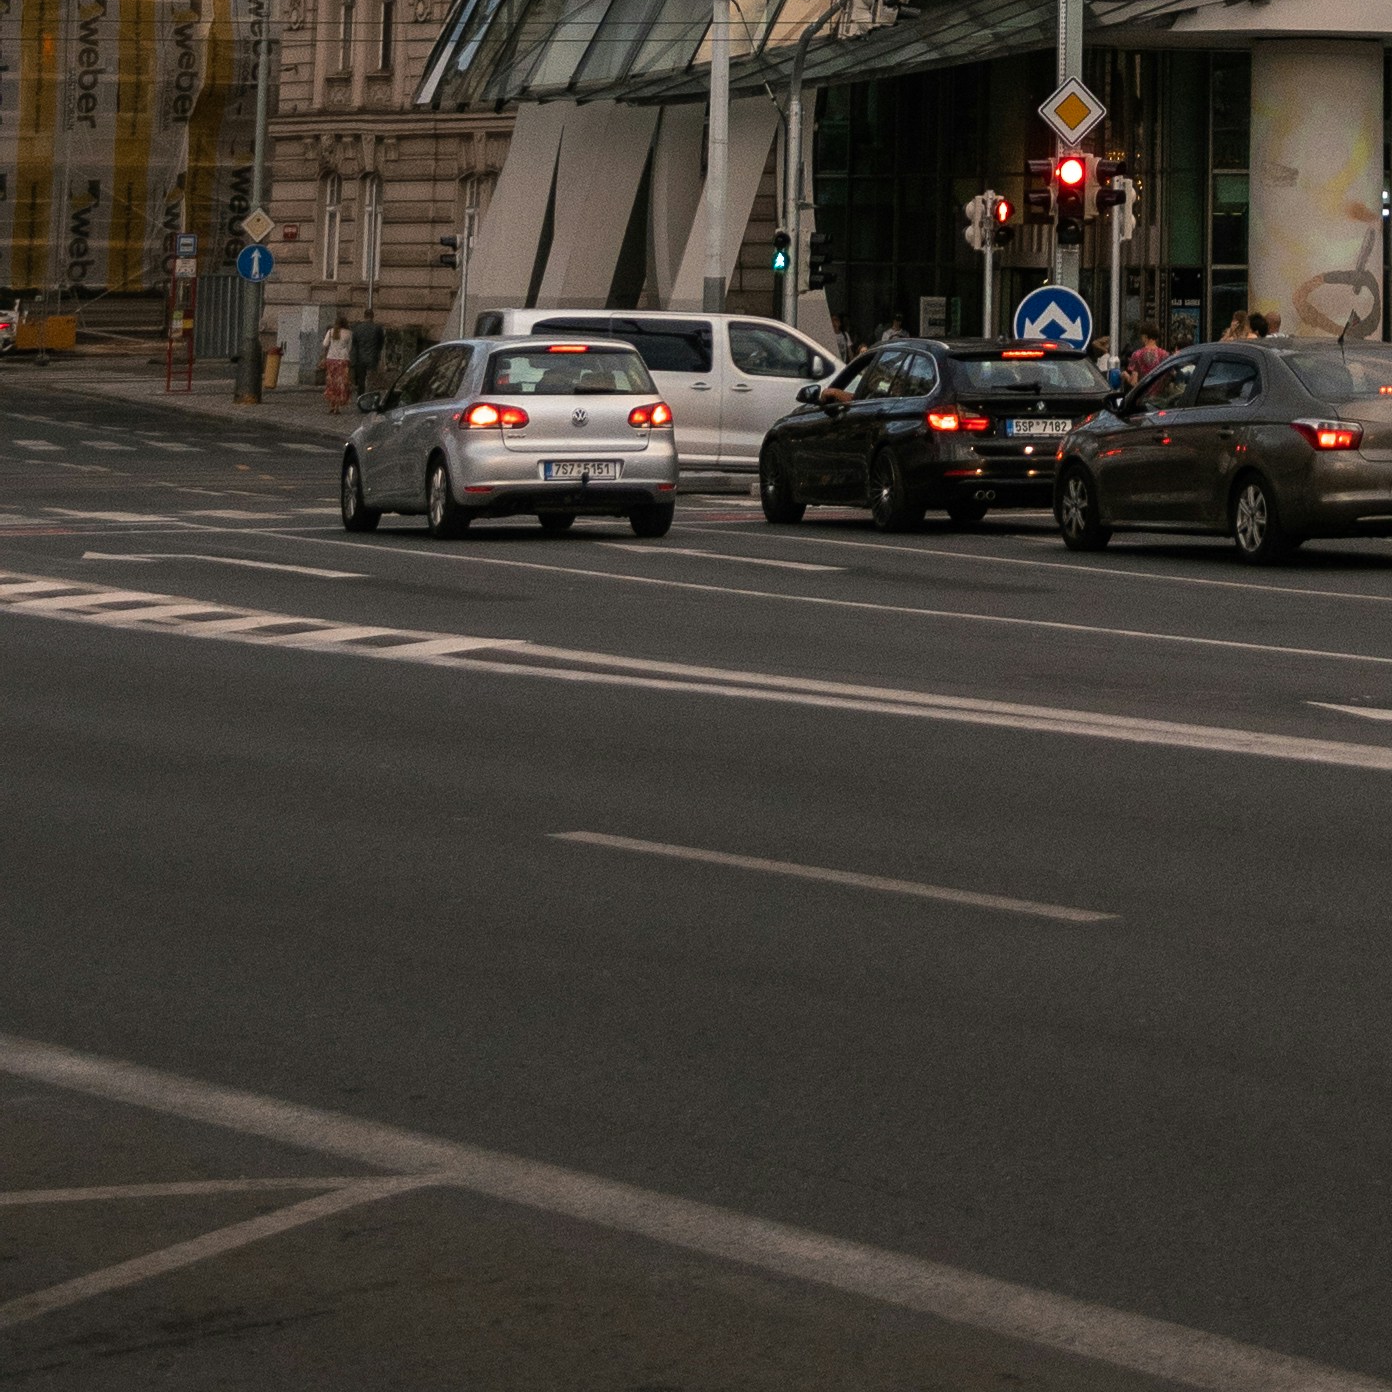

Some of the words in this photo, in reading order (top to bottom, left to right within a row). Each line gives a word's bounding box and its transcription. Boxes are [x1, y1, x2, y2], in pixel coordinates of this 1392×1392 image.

[77, 16, 106, 129] weber
[1014, 420, 1035, 433] 5SP
[1042, 420, 1067, 433] 7182
[554, 462, 575, 476] 7S7
[583, 462, 611, 476] 5151
